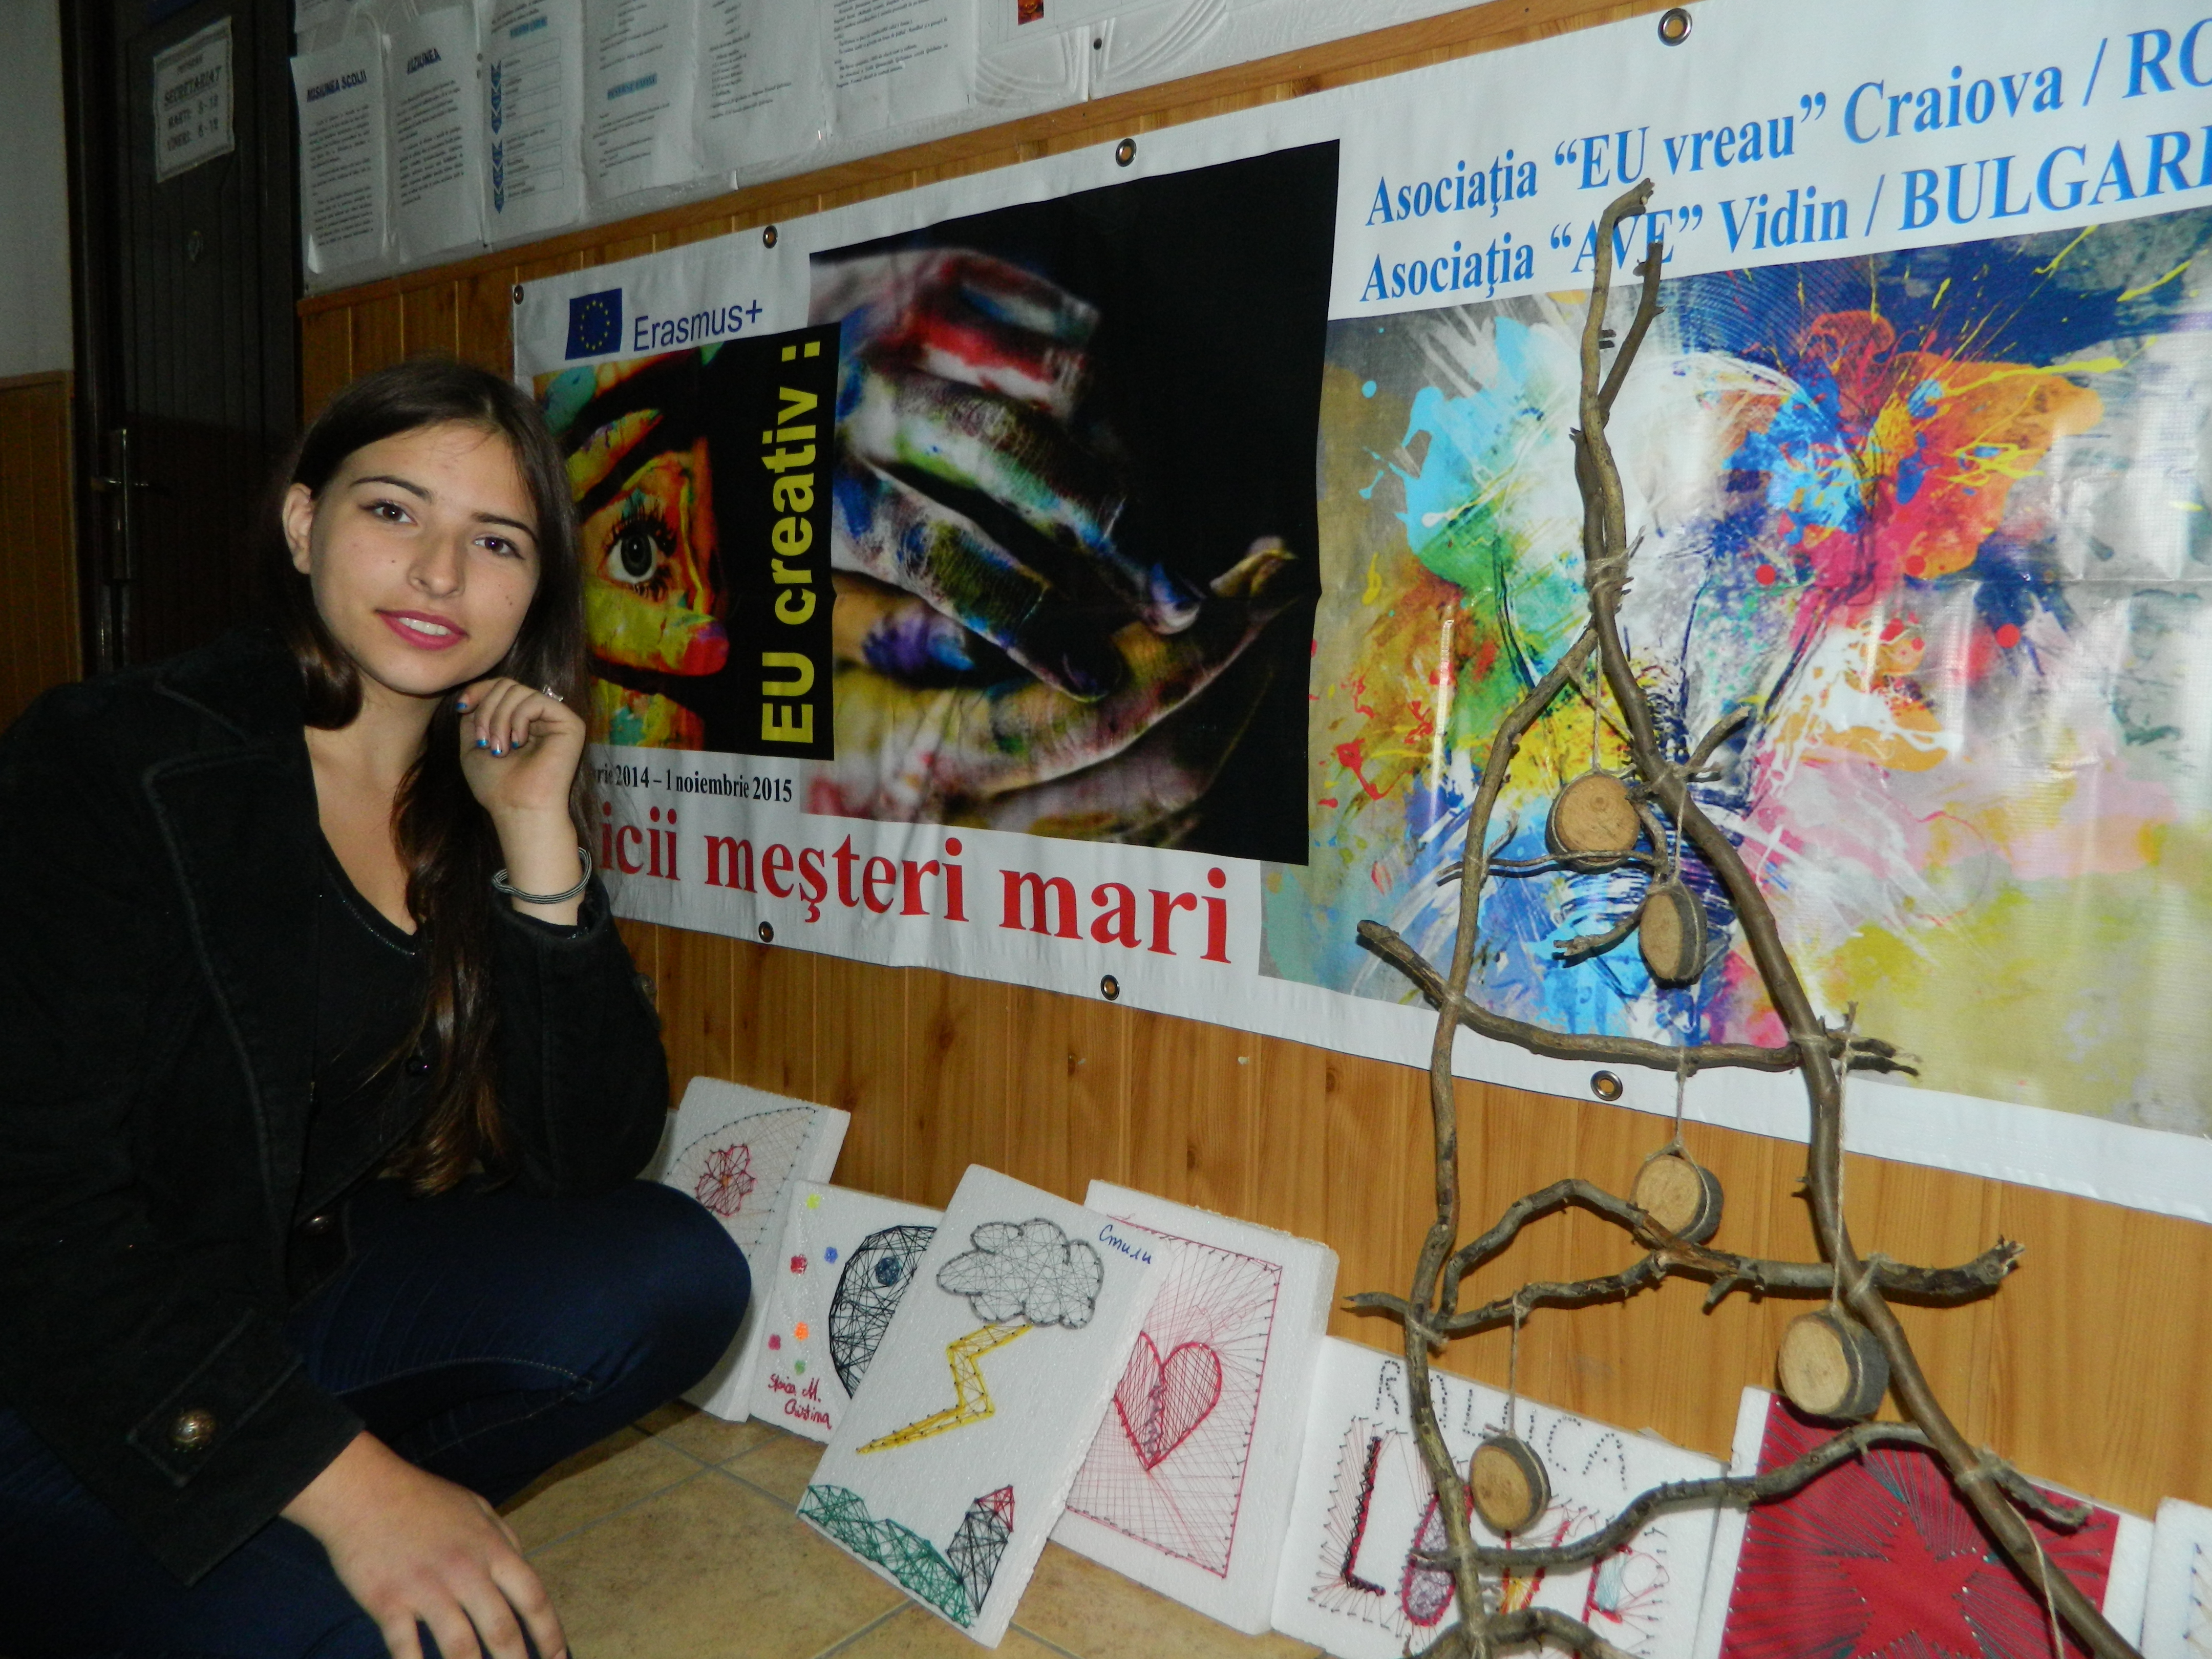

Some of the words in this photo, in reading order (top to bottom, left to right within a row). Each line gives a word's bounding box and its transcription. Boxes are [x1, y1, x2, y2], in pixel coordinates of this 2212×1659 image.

[1365, 149, 1538, 226] Asociaţia
[1844, 66, 2064, 144] Craiova
[1359, 232, 1535, 302] Asociaţia
[1718, 185, 1848, 253] Vidin
[633, 300, 763, 352] Erasmus+
[761, 386, 819, 625] creativ
[761, 652, 815, 743] EU
[616, 764, 649, 789] 2014
[675, 771, 750, 799] noiembrie
[753, 776, 793, 803] 2015
[599, 801, 681, 881] icii
[704, 833, 969, 923] meşteri
[999, 867, 1231, 964] mari
